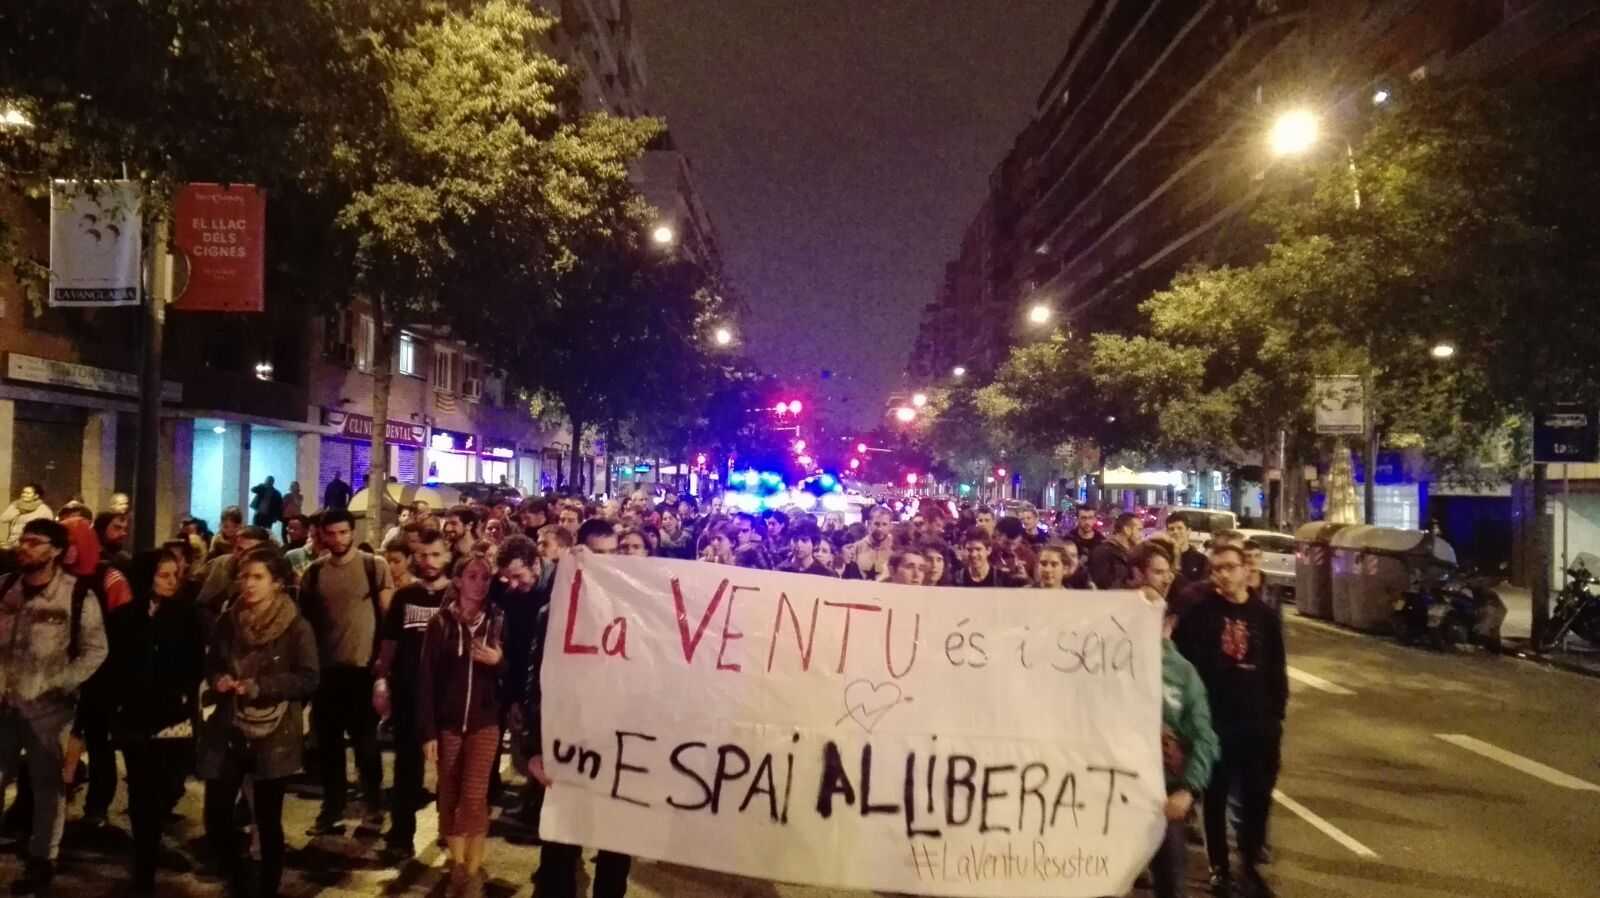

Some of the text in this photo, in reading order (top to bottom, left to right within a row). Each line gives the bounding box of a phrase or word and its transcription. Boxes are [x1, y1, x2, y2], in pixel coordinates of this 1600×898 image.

[192, 218, 246, 231] EL LLAC
[202, 232, 237, 244] DELS
[192, 245, 247, 257] CIGNES
[386, 423, 412, 441] DENTAL
[563, 569, 1136, 681] La VENTU és i serà
[553, 739, 601, 779] un
